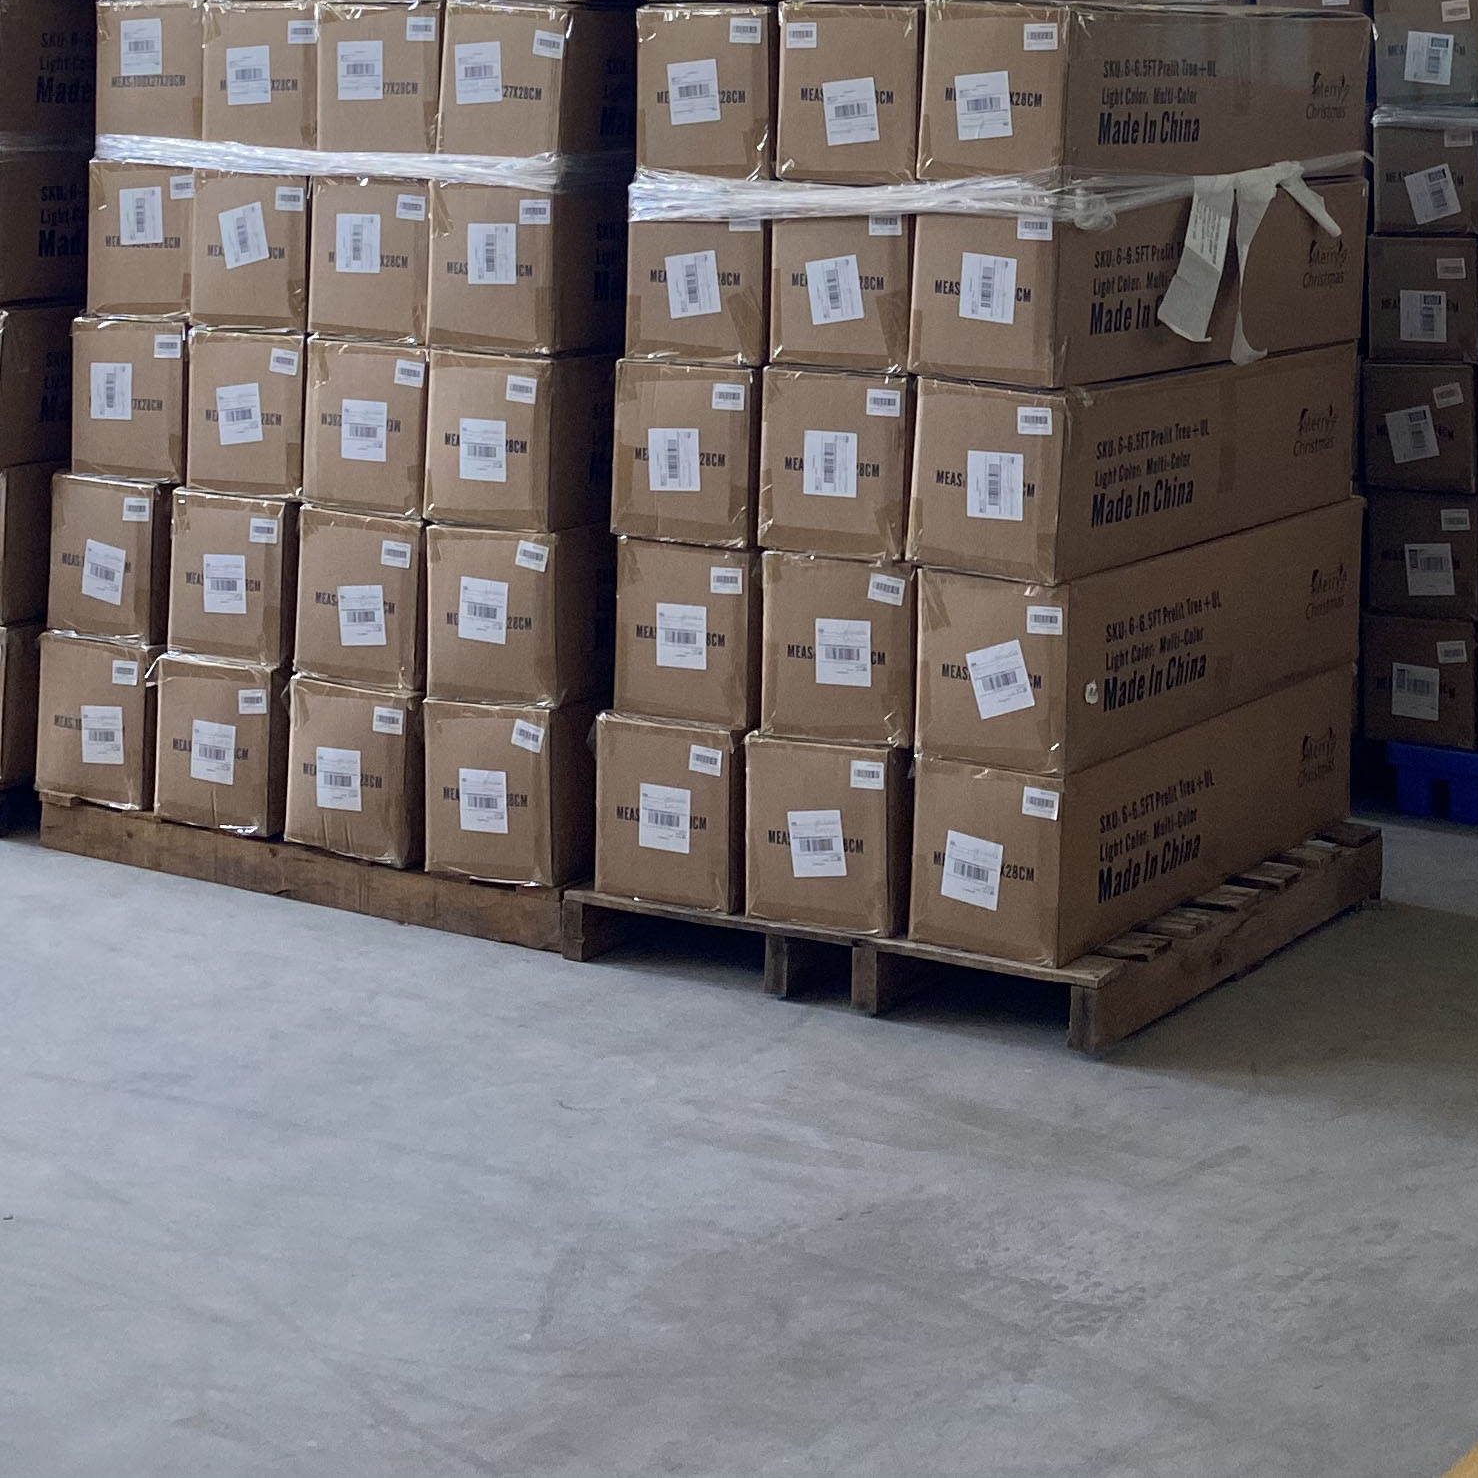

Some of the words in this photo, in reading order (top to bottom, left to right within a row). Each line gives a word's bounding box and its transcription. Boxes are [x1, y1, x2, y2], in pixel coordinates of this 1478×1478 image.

[1102, 88, 1123, 109] Light
[1306, 103, 1347, 121] Christmas
[1098, 112, 1140, 145] Made
[1142, 112, 1157, 144] In
[1160, 110, 1200, 144] China
[1093, 278, 1116, 298] Light
[1303, 271, 1344, 288] Christmas
[1090, 301, 1134, 336] Made
[1136, 298, 1150, 328] In
[1095, 466, 1117, 490] Light
[1092, 490, 1132, 528] Made
[1136, 484, 1150, 516] In
[1154, 476, 1194, 512] China
[1106, 650, 1129, 672] Light
[1104, 669, 1146, 712] Made
[1148, 664, 1164, 696] In
[1166, 652, 1207, 690] China
[1100, 839, 1123, 863] Light
[1098, 862, 1140, 904] Made
[1143, 851, 1157, 881] In
[1160, 833, 1201, 874] China
